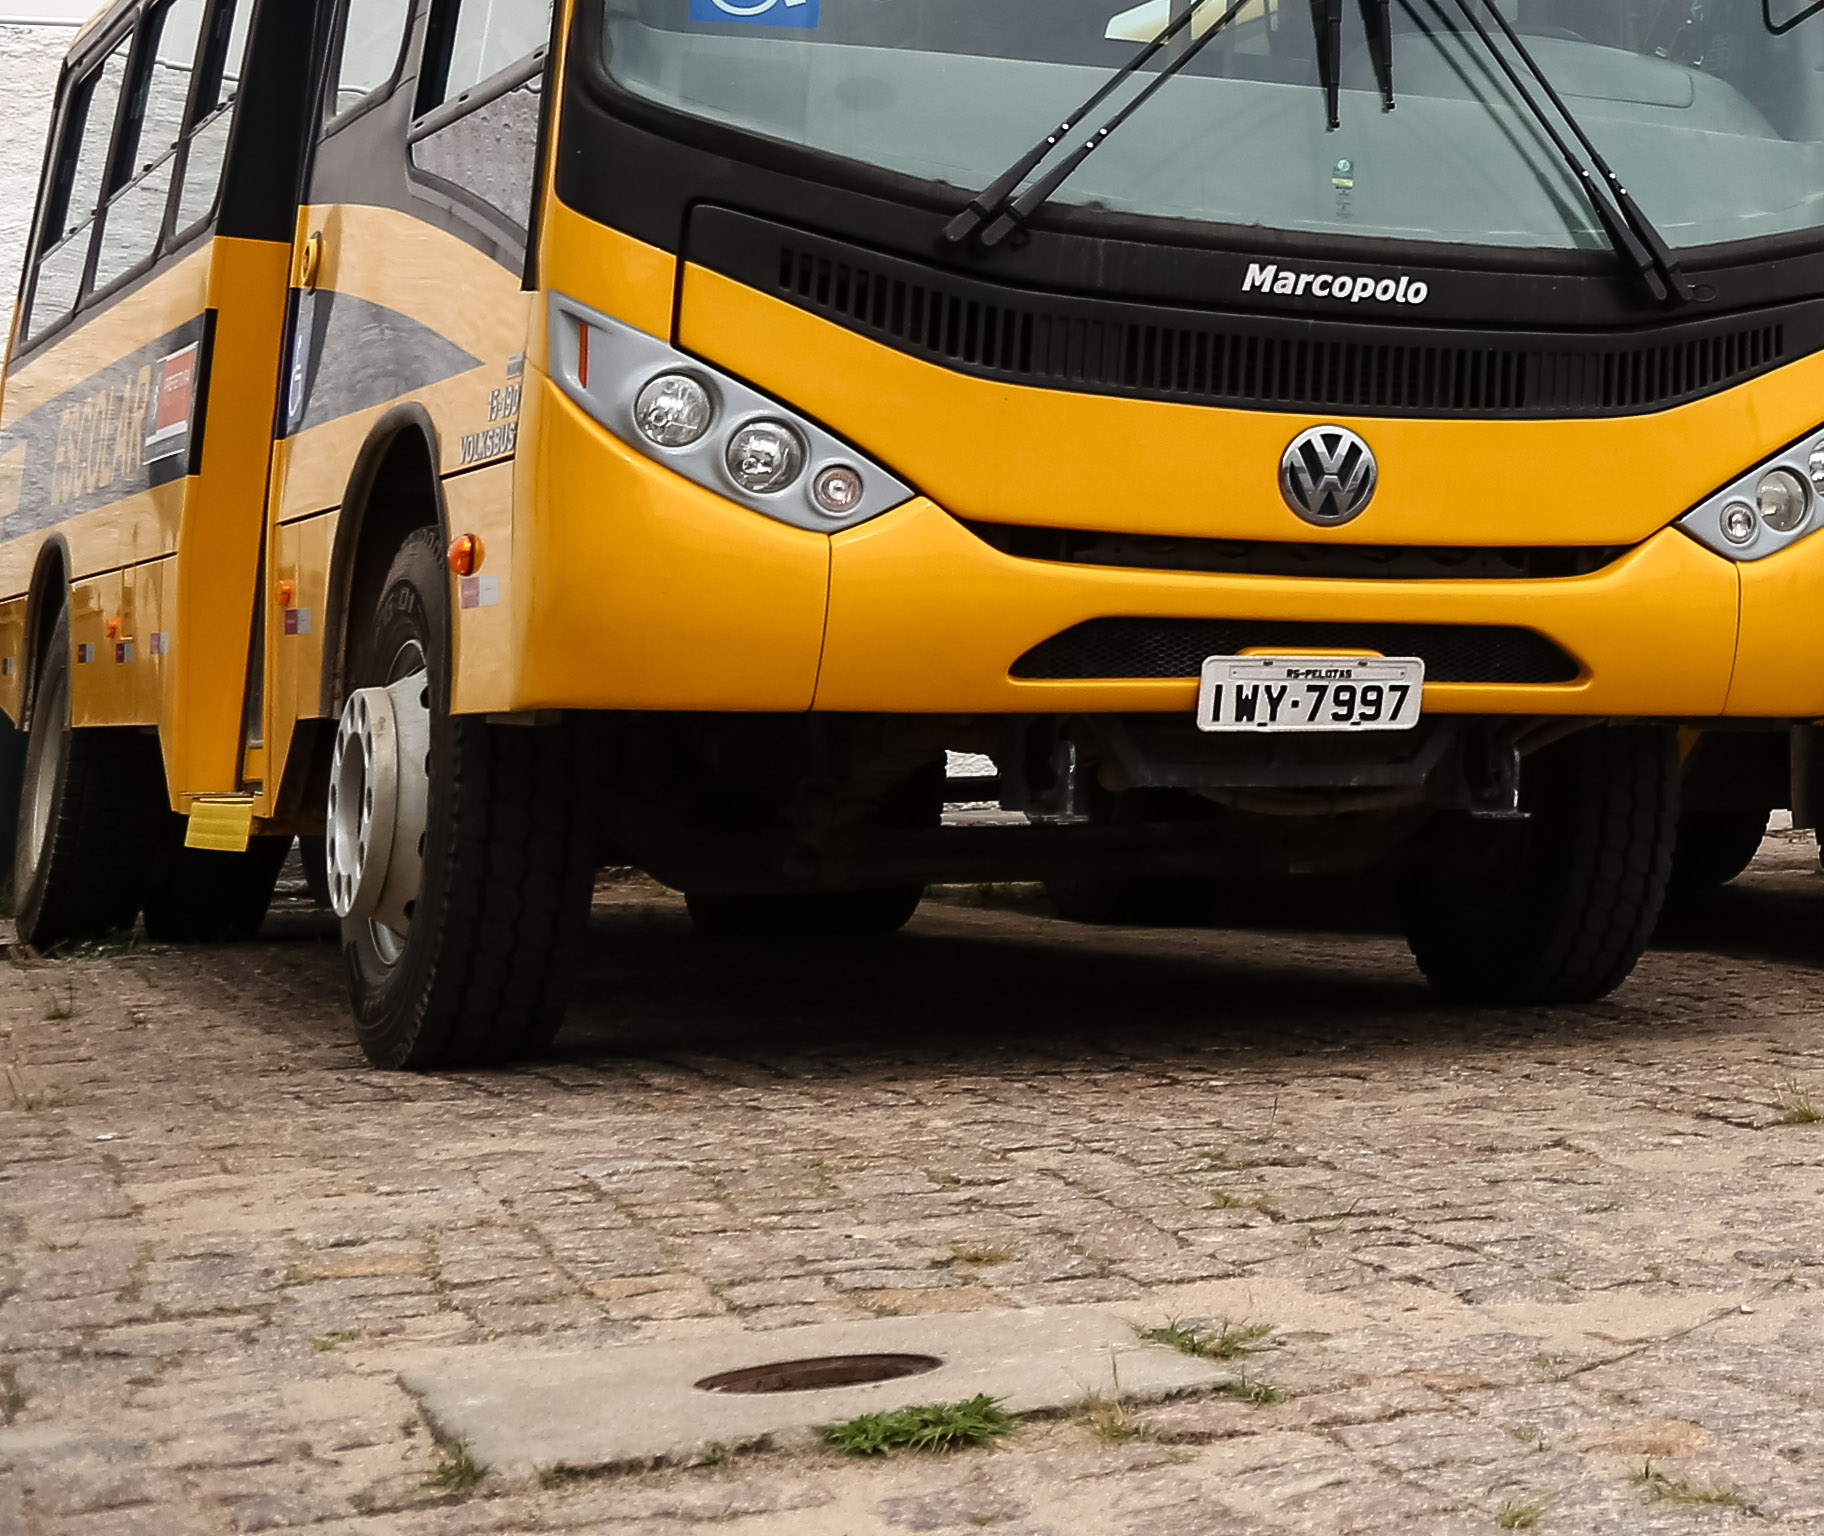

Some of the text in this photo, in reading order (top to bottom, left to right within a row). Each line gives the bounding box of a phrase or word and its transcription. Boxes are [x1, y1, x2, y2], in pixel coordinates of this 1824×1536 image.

[1242, 263, 1429, 304] Marcopolo
[460, 422, 518, 465] VOLKSBUS
[1286, 669, 1352, 679] RS-PELOTAS
